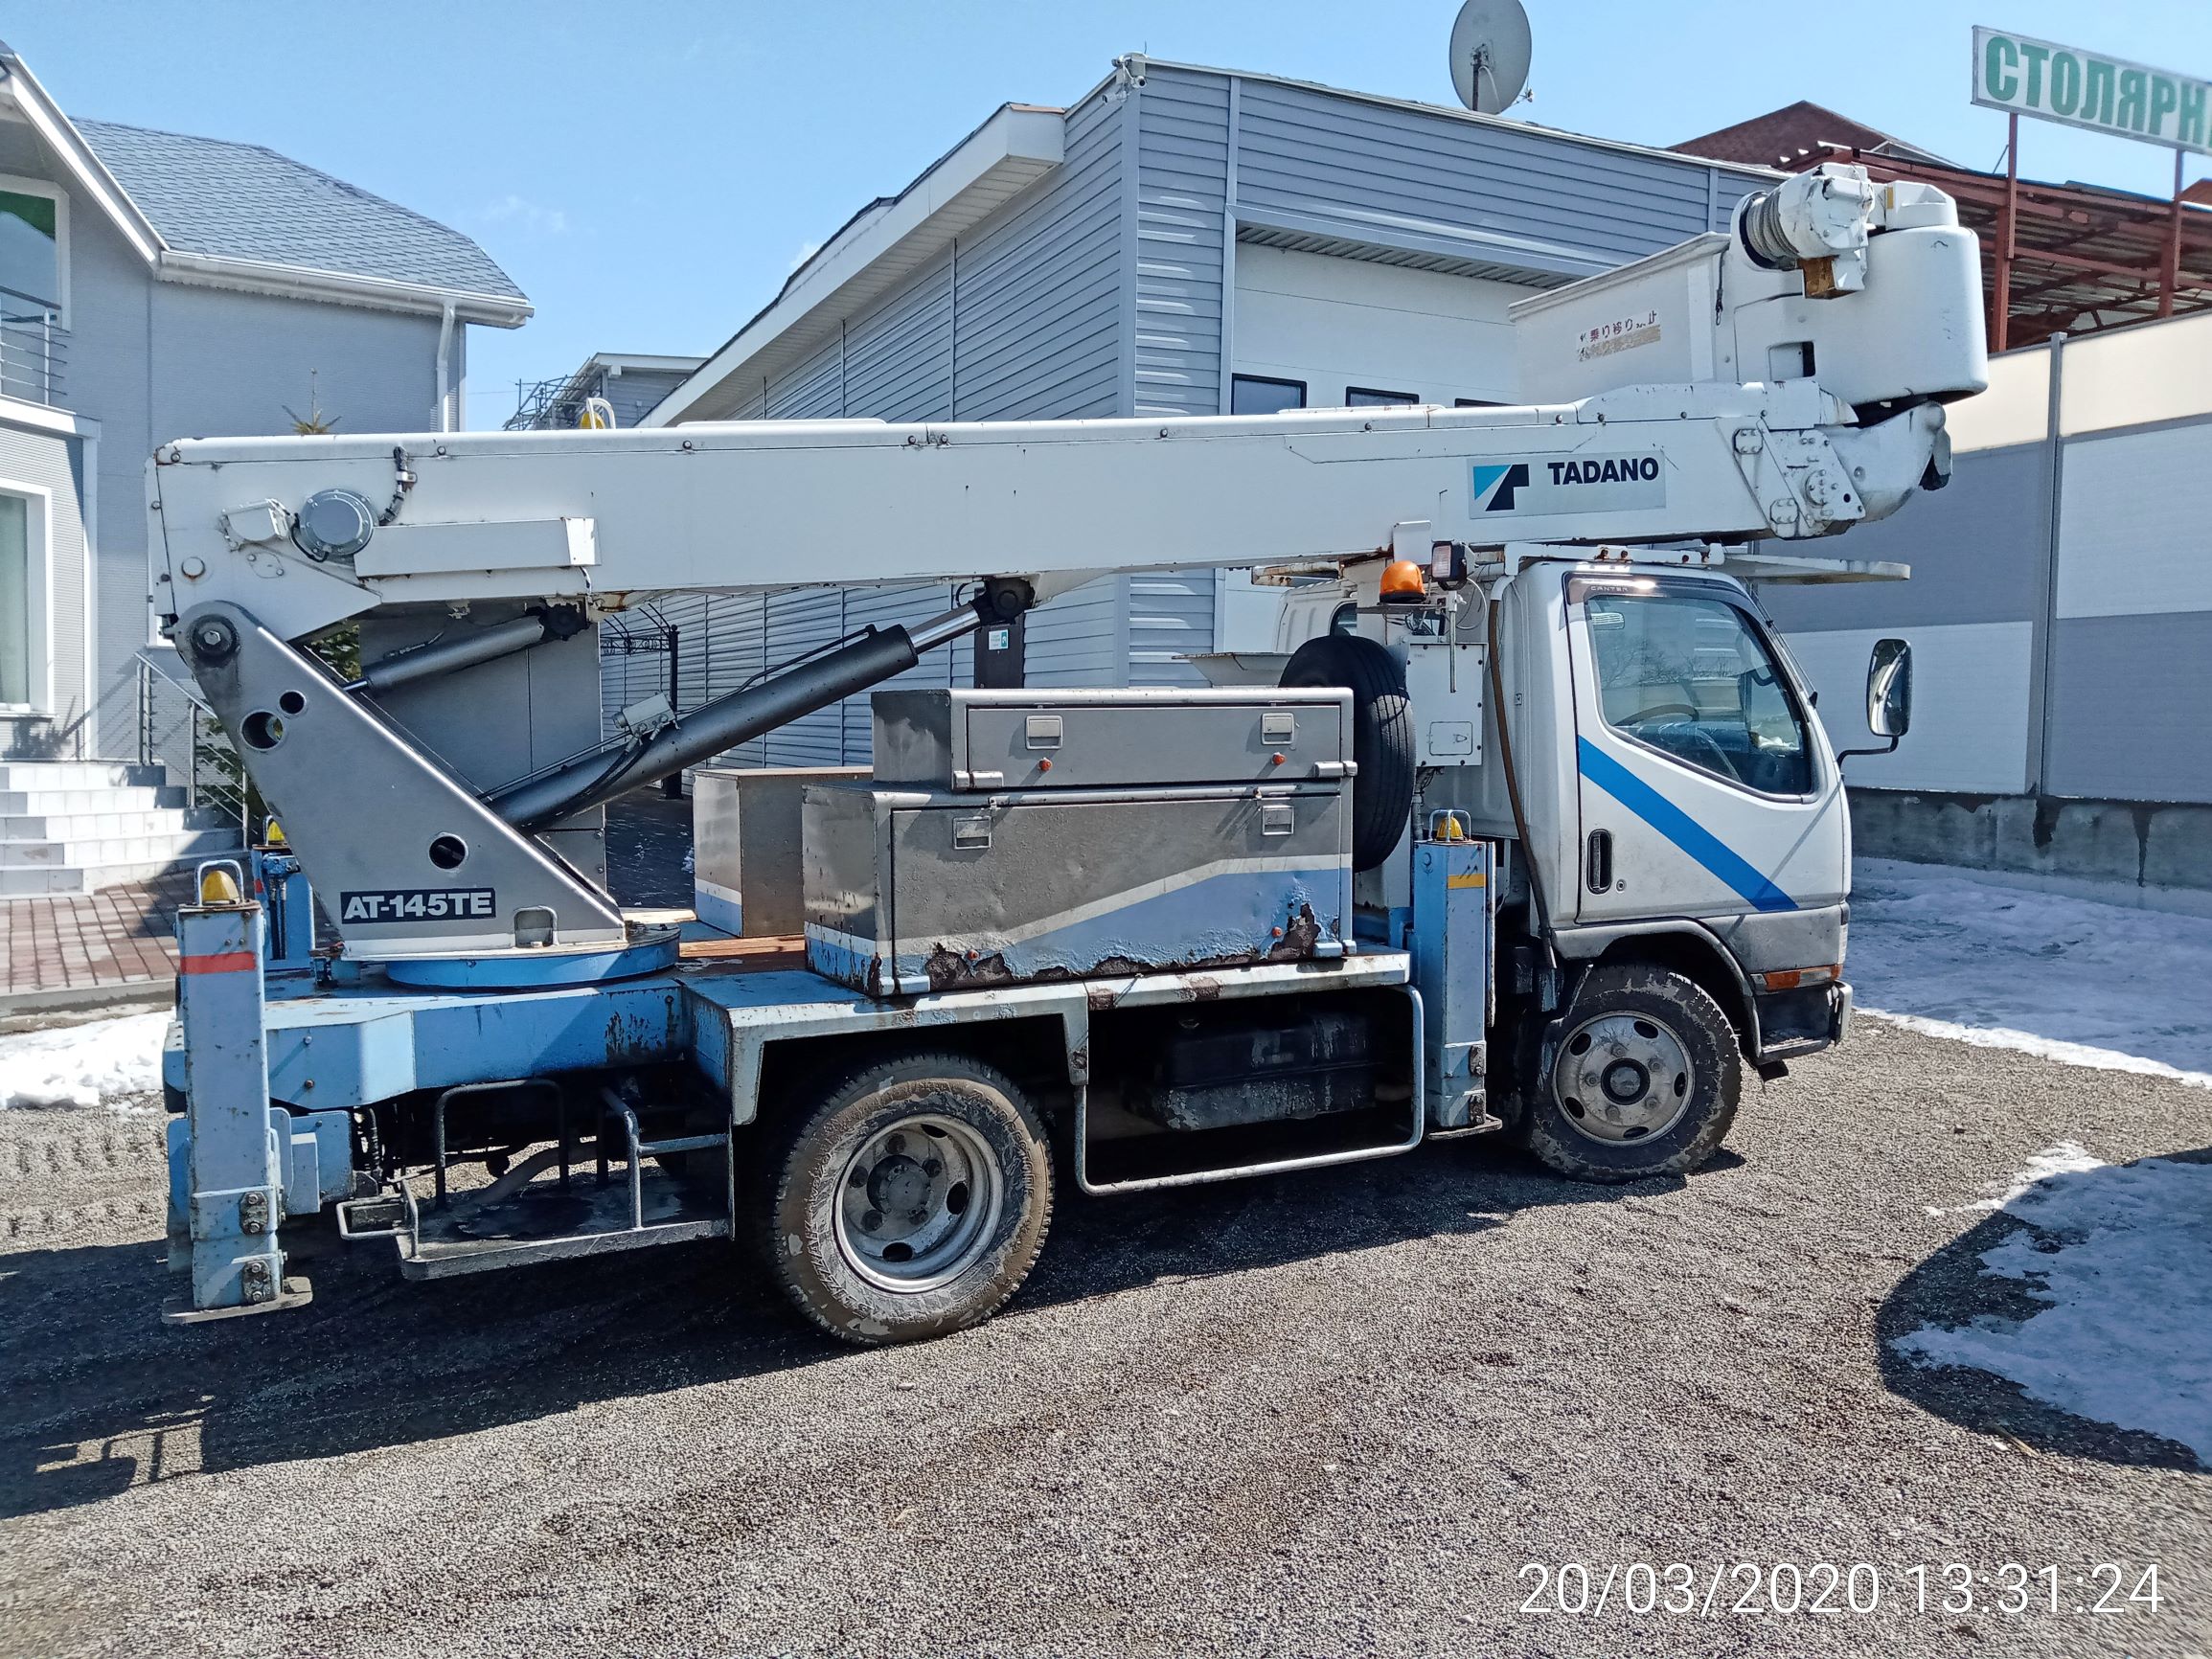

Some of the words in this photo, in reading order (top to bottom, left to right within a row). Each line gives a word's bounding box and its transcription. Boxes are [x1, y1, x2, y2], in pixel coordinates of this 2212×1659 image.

[1985, 36, 2212, 149] СТОЛЯРН
[1547, 457, 1659, 486] TADANO
[343, 892, 492, 920] AT-145TE
